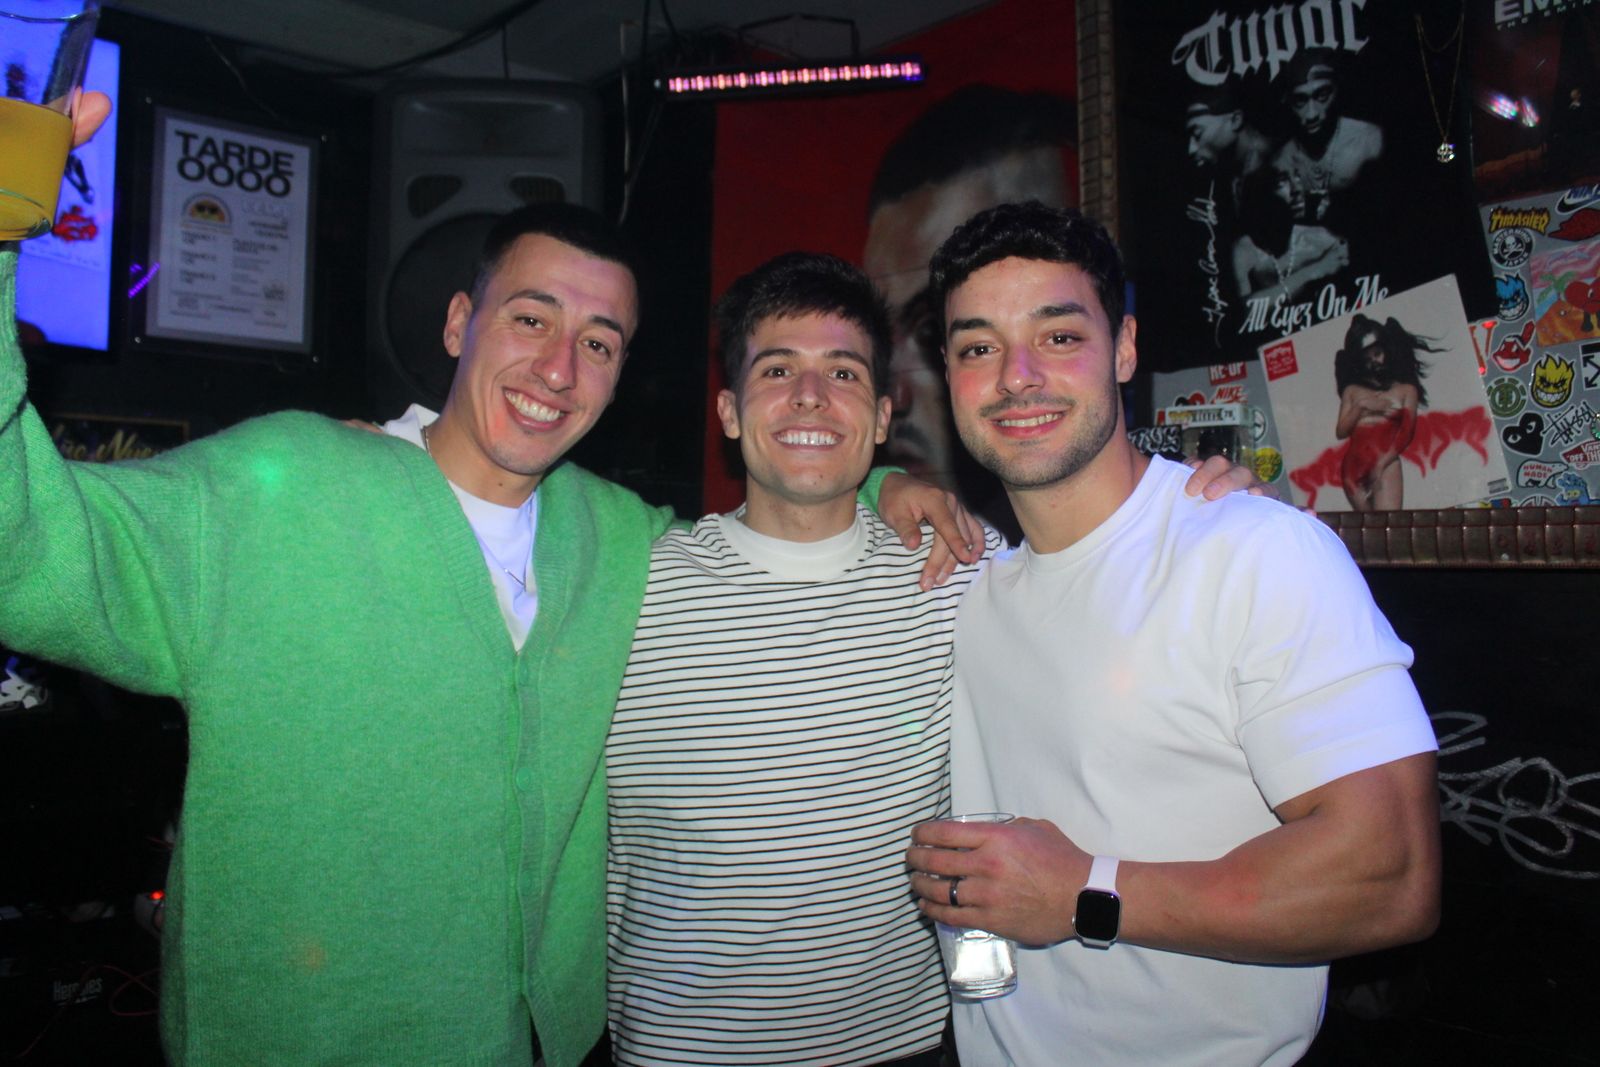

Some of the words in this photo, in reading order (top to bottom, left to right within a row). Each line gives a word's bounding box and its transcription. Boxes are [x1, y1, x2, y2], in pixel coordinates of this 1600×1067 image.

[1171, 0, 1370, 86] Tupac
[174, 130, 294, 177] TARDE
[1489, 207, 1550, 236] THRASHER
[1238, 296, 1270, 335] All
[1270, 293, 1314, 337] Eyez
[1317, 282, 1349, 320] On
[1350, 273, 1390, 313] Me
[1216, 386, 1243, 400] NIKE
